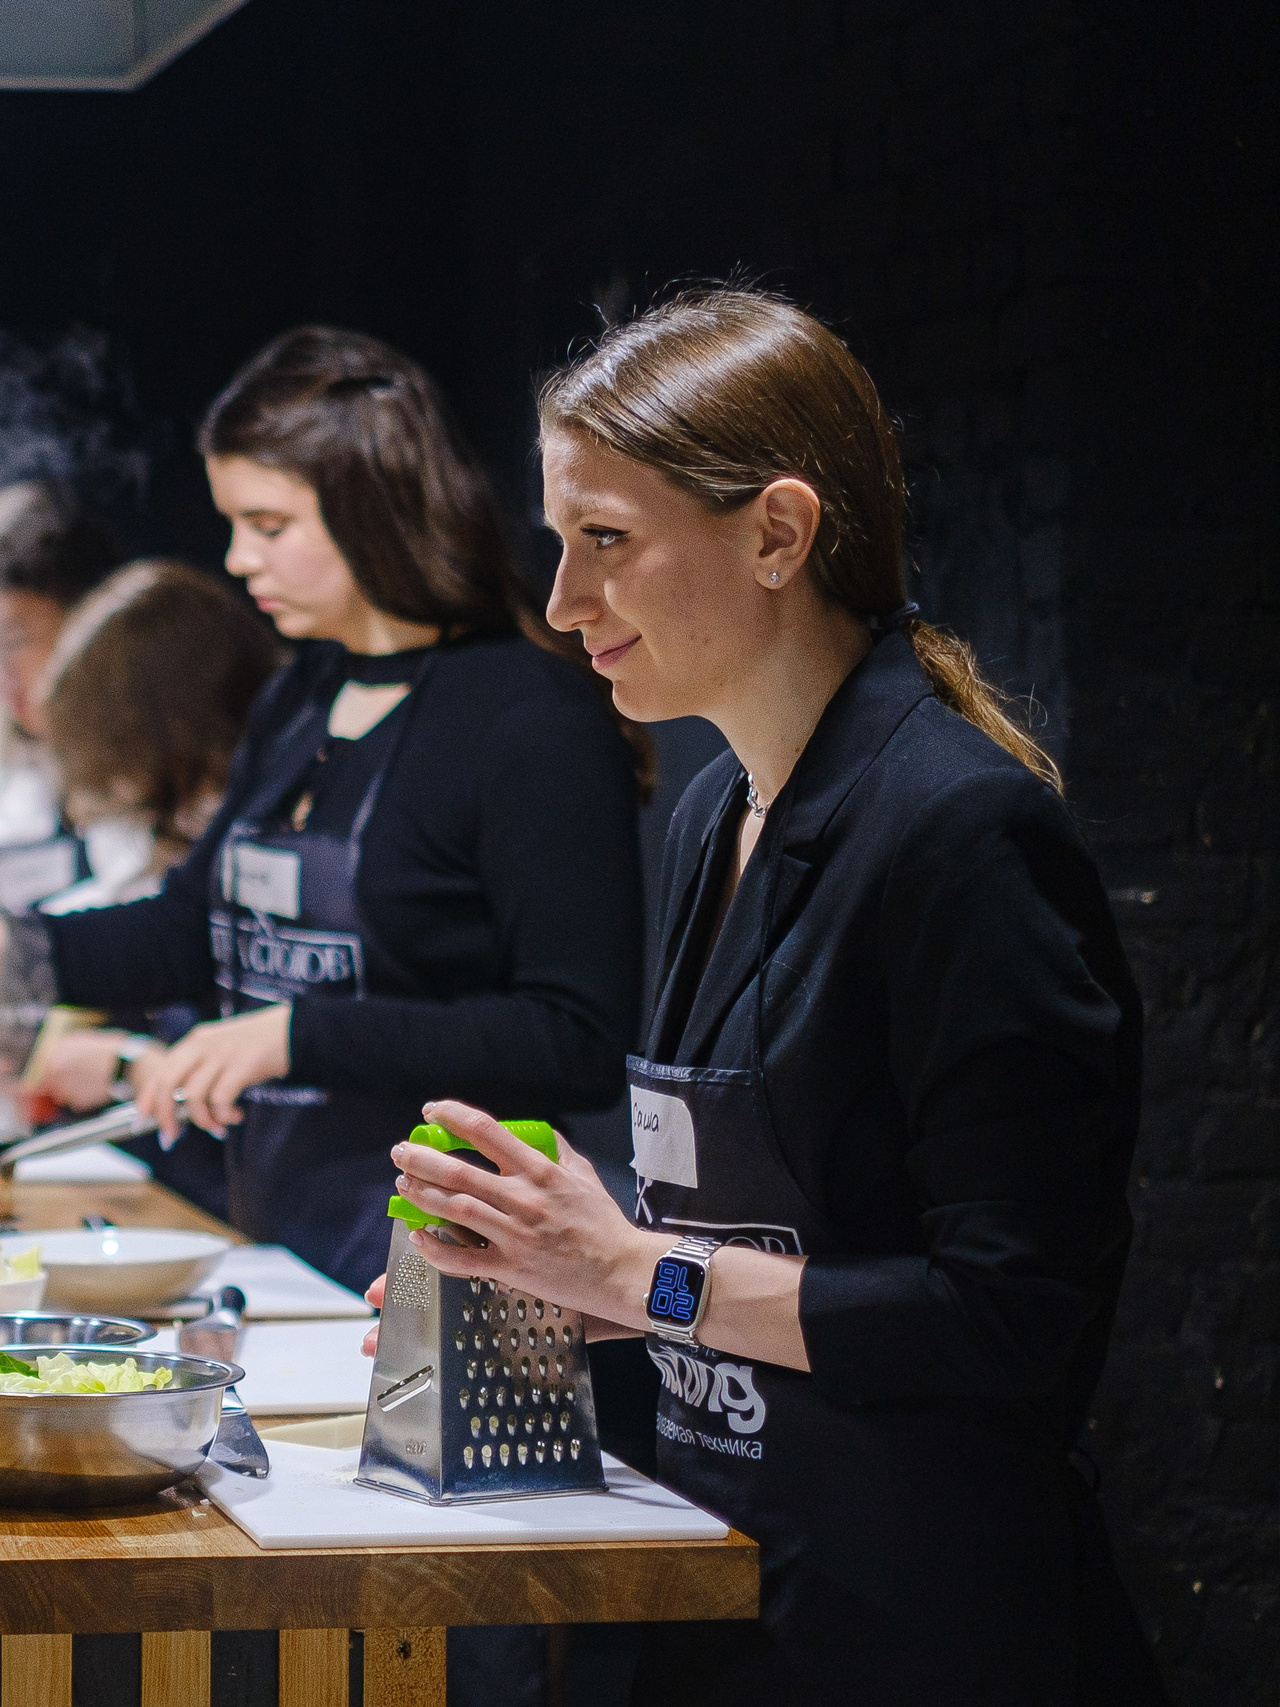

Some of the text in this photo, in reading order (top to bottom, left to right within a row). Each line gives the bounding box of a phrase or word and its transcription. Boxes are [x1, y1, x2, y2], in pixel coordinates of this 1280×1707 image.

[656, 1262, 689, 1293] 16
[650, 1287, 695, 1320] 20
[695, 1431, 763, 1460] техника
